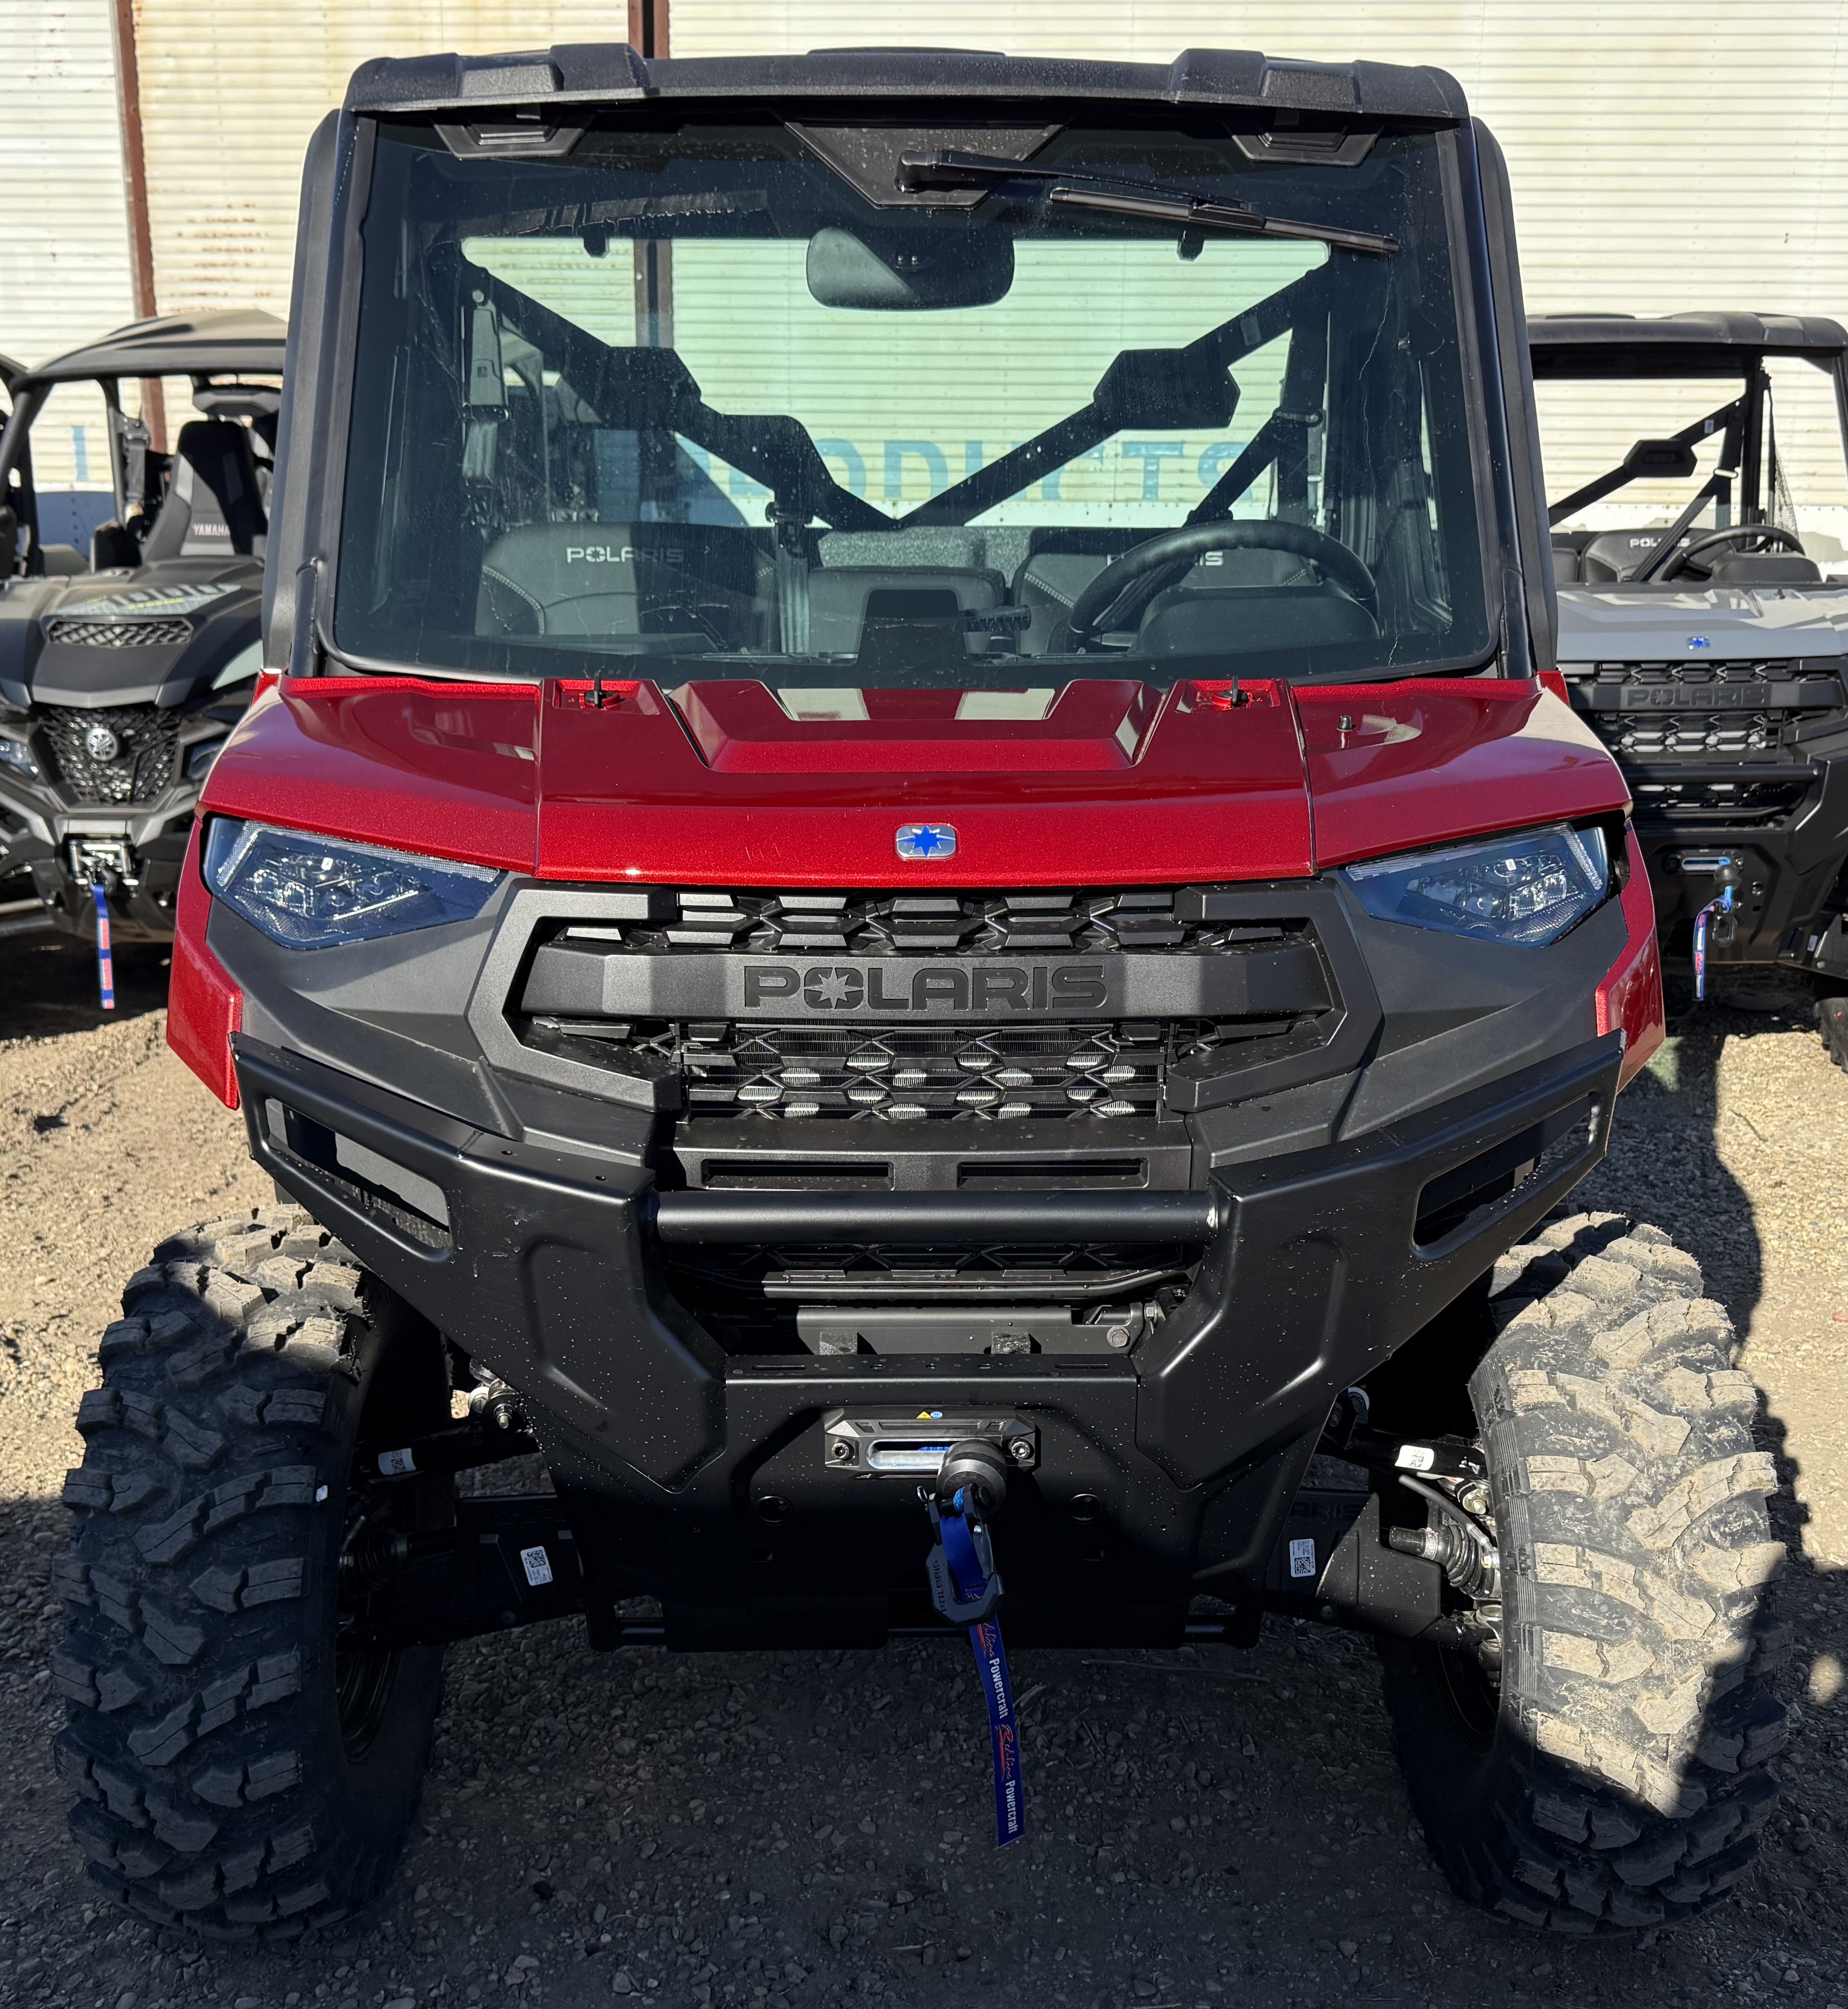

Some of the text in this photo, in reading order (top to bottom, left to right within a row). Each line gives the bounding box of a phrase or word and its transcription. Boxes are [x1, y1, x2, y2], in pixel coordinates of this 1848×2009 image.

[192, 523, 230, 536] YAMAHA
[566, 546, 684, 563] POLARIS
[1627, 688, 1764, 706] POLARIS
[744, 965, 1108, 1011] POLARIS
[989, 1658, 1008, 1719] Powercraft
[1005, 1780, 1019, 1834] Powercraft
